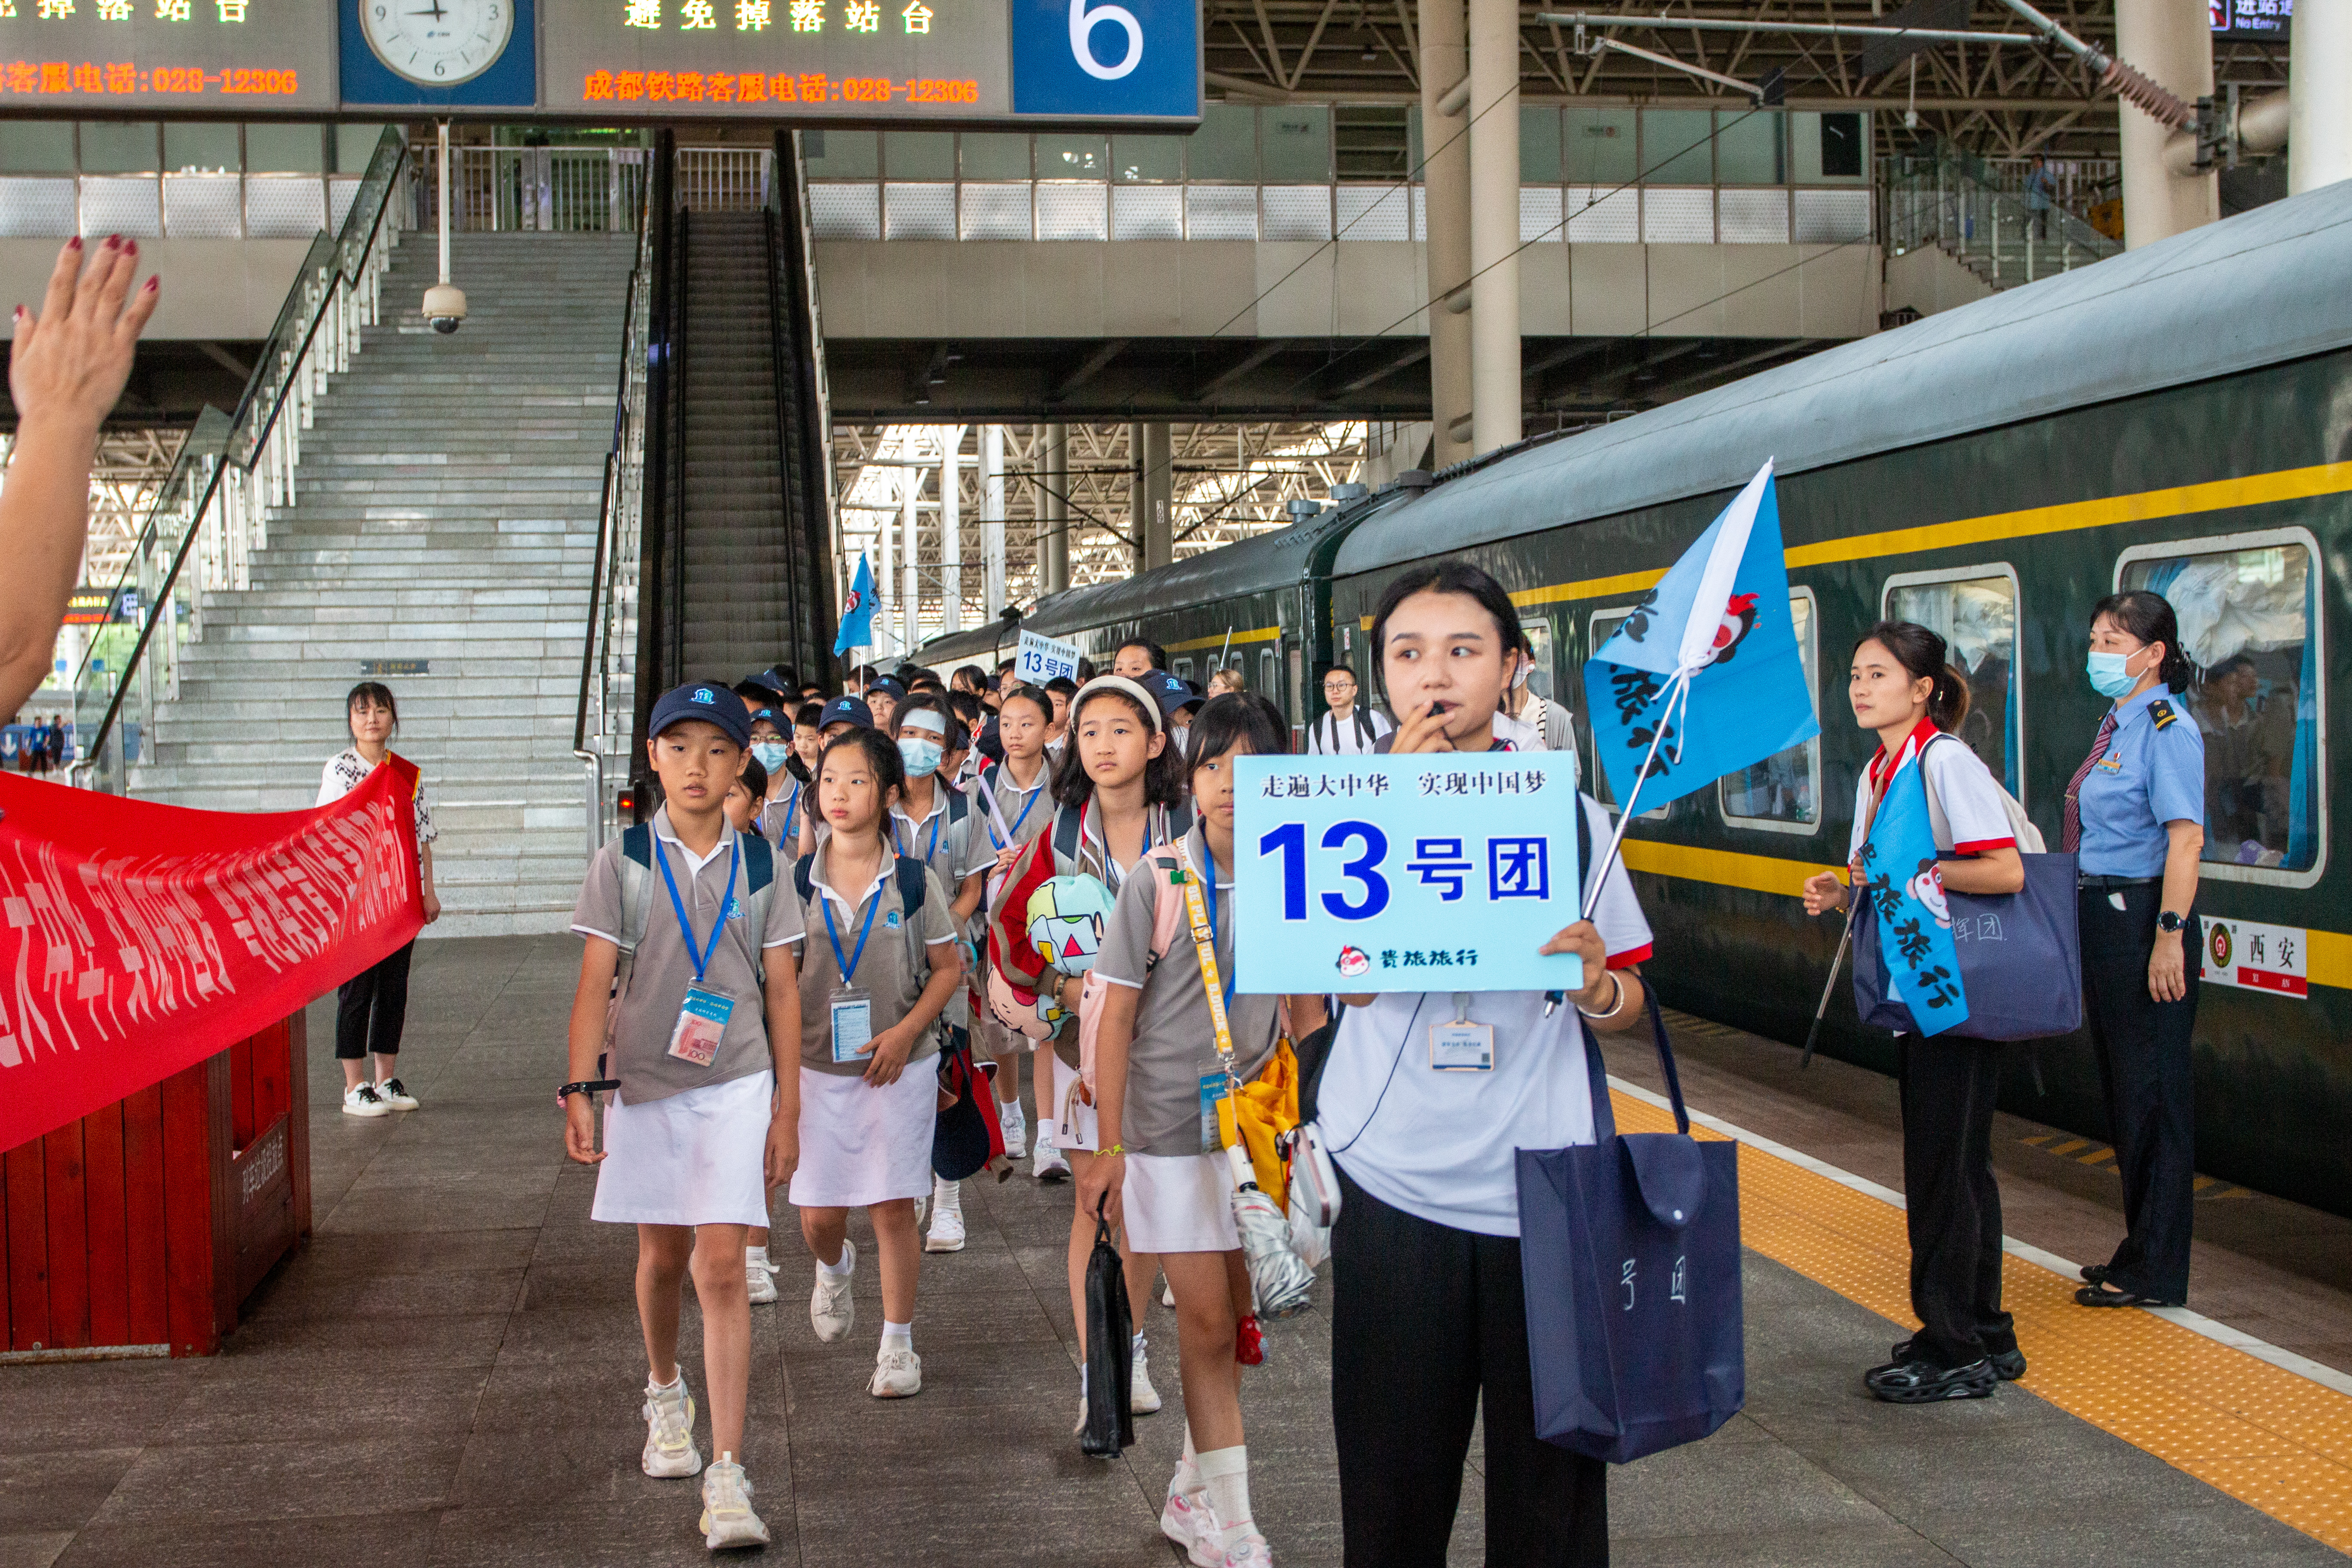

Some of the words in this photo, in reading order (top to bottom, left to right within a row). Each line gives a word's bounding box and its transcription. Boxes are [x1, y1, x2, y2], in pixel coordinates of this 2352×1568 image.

[375, 5, 386, 21] 9
[488, 4, 499, 20] 3
[625, 0, 934, 34] 避免掉落站台
[2236, 17, 2251, 29] No
[2252, 17, 2282, 31] Entry
[1069, 0, 1144, 80] 6
[0, 61, 297, 94] 客服电话:028-12306
[434, 60, 445, 76] 6
[1024, 650, 1073, 680] 13号团
[1260, 772, 1390, 799] 走遍大中华
[1417, 770, 1547, 796] 实现中国梦
[1259, 819, 1550, 922] 13号团
[1187, 885, 1200, 902] BE
[1208, 982, 1227, 1032] B.DUCK
[2249, 933, 2294, 969] 西安
